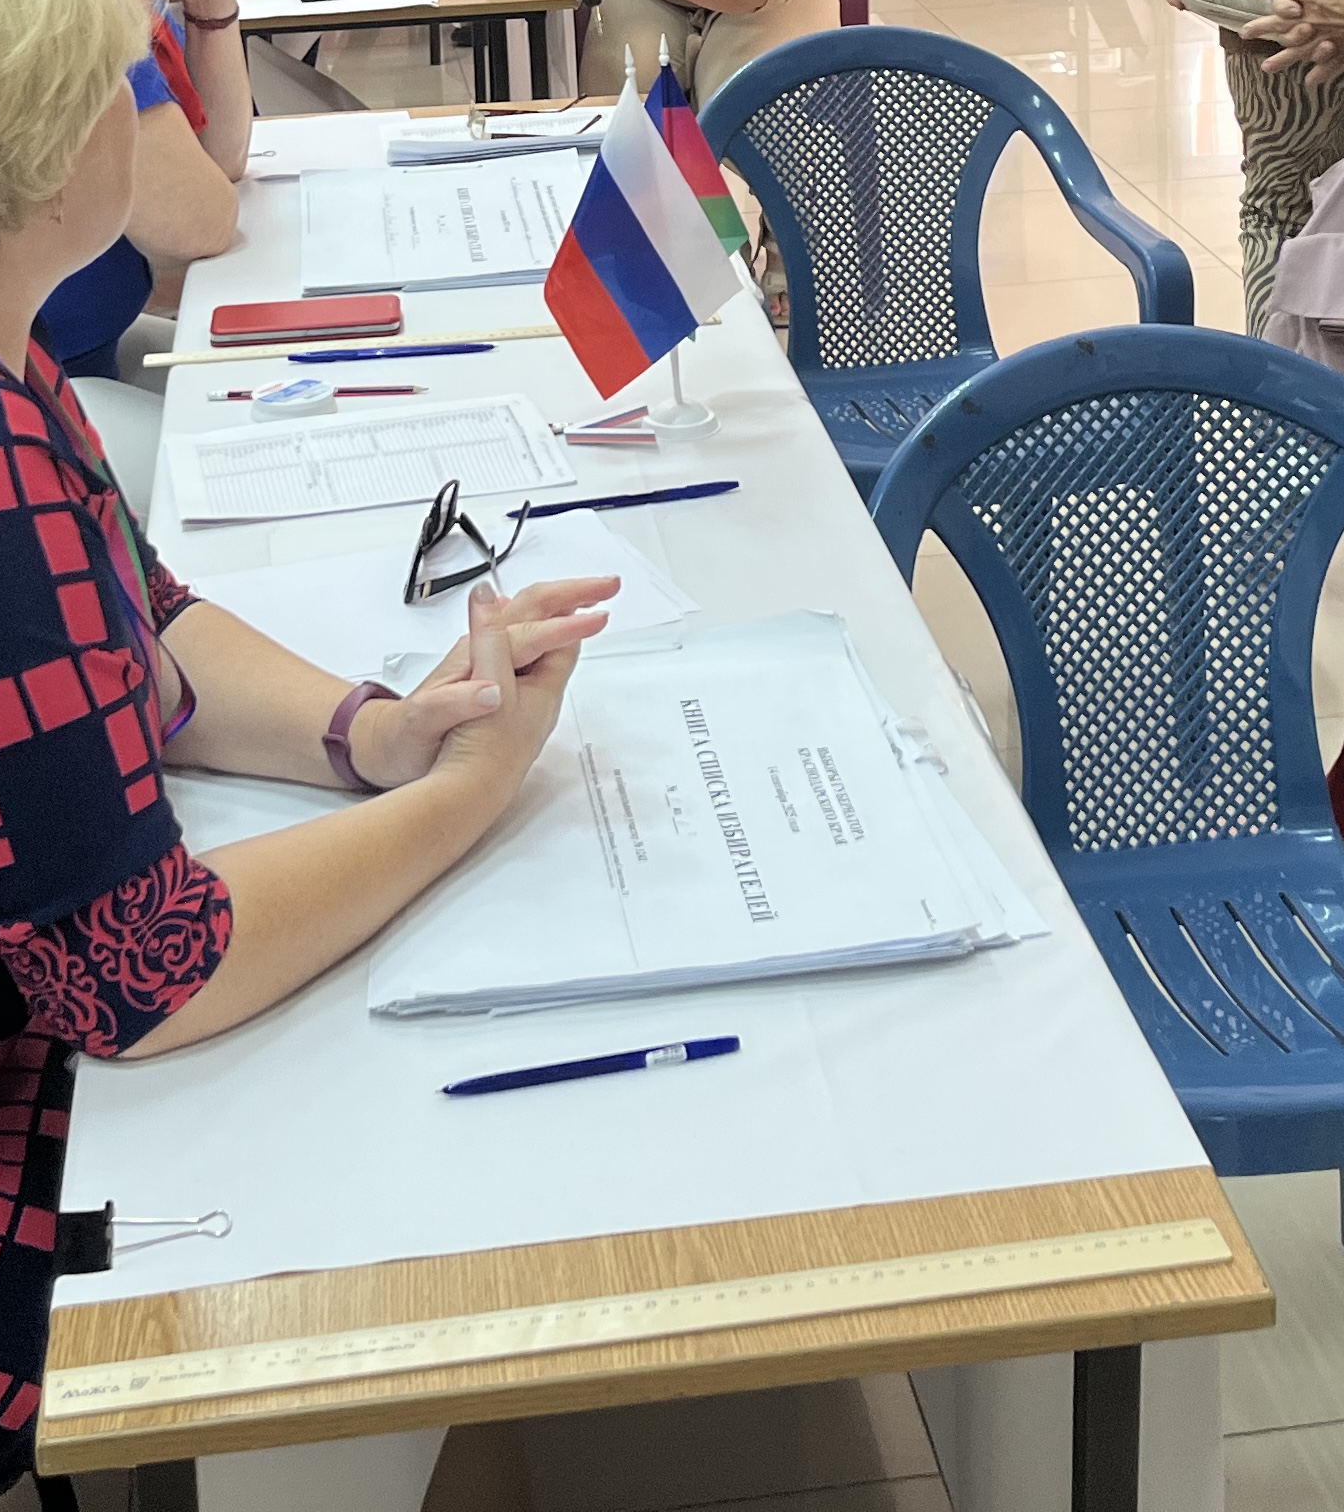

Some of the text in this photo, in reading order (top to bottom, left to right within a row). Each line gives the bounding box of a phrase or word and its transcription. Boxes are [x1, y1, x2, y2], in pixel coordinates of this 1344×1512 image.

[680, 699, 779, 923] КНИГА СПИСКА ИЗБИРАТЕЛЕЙ
